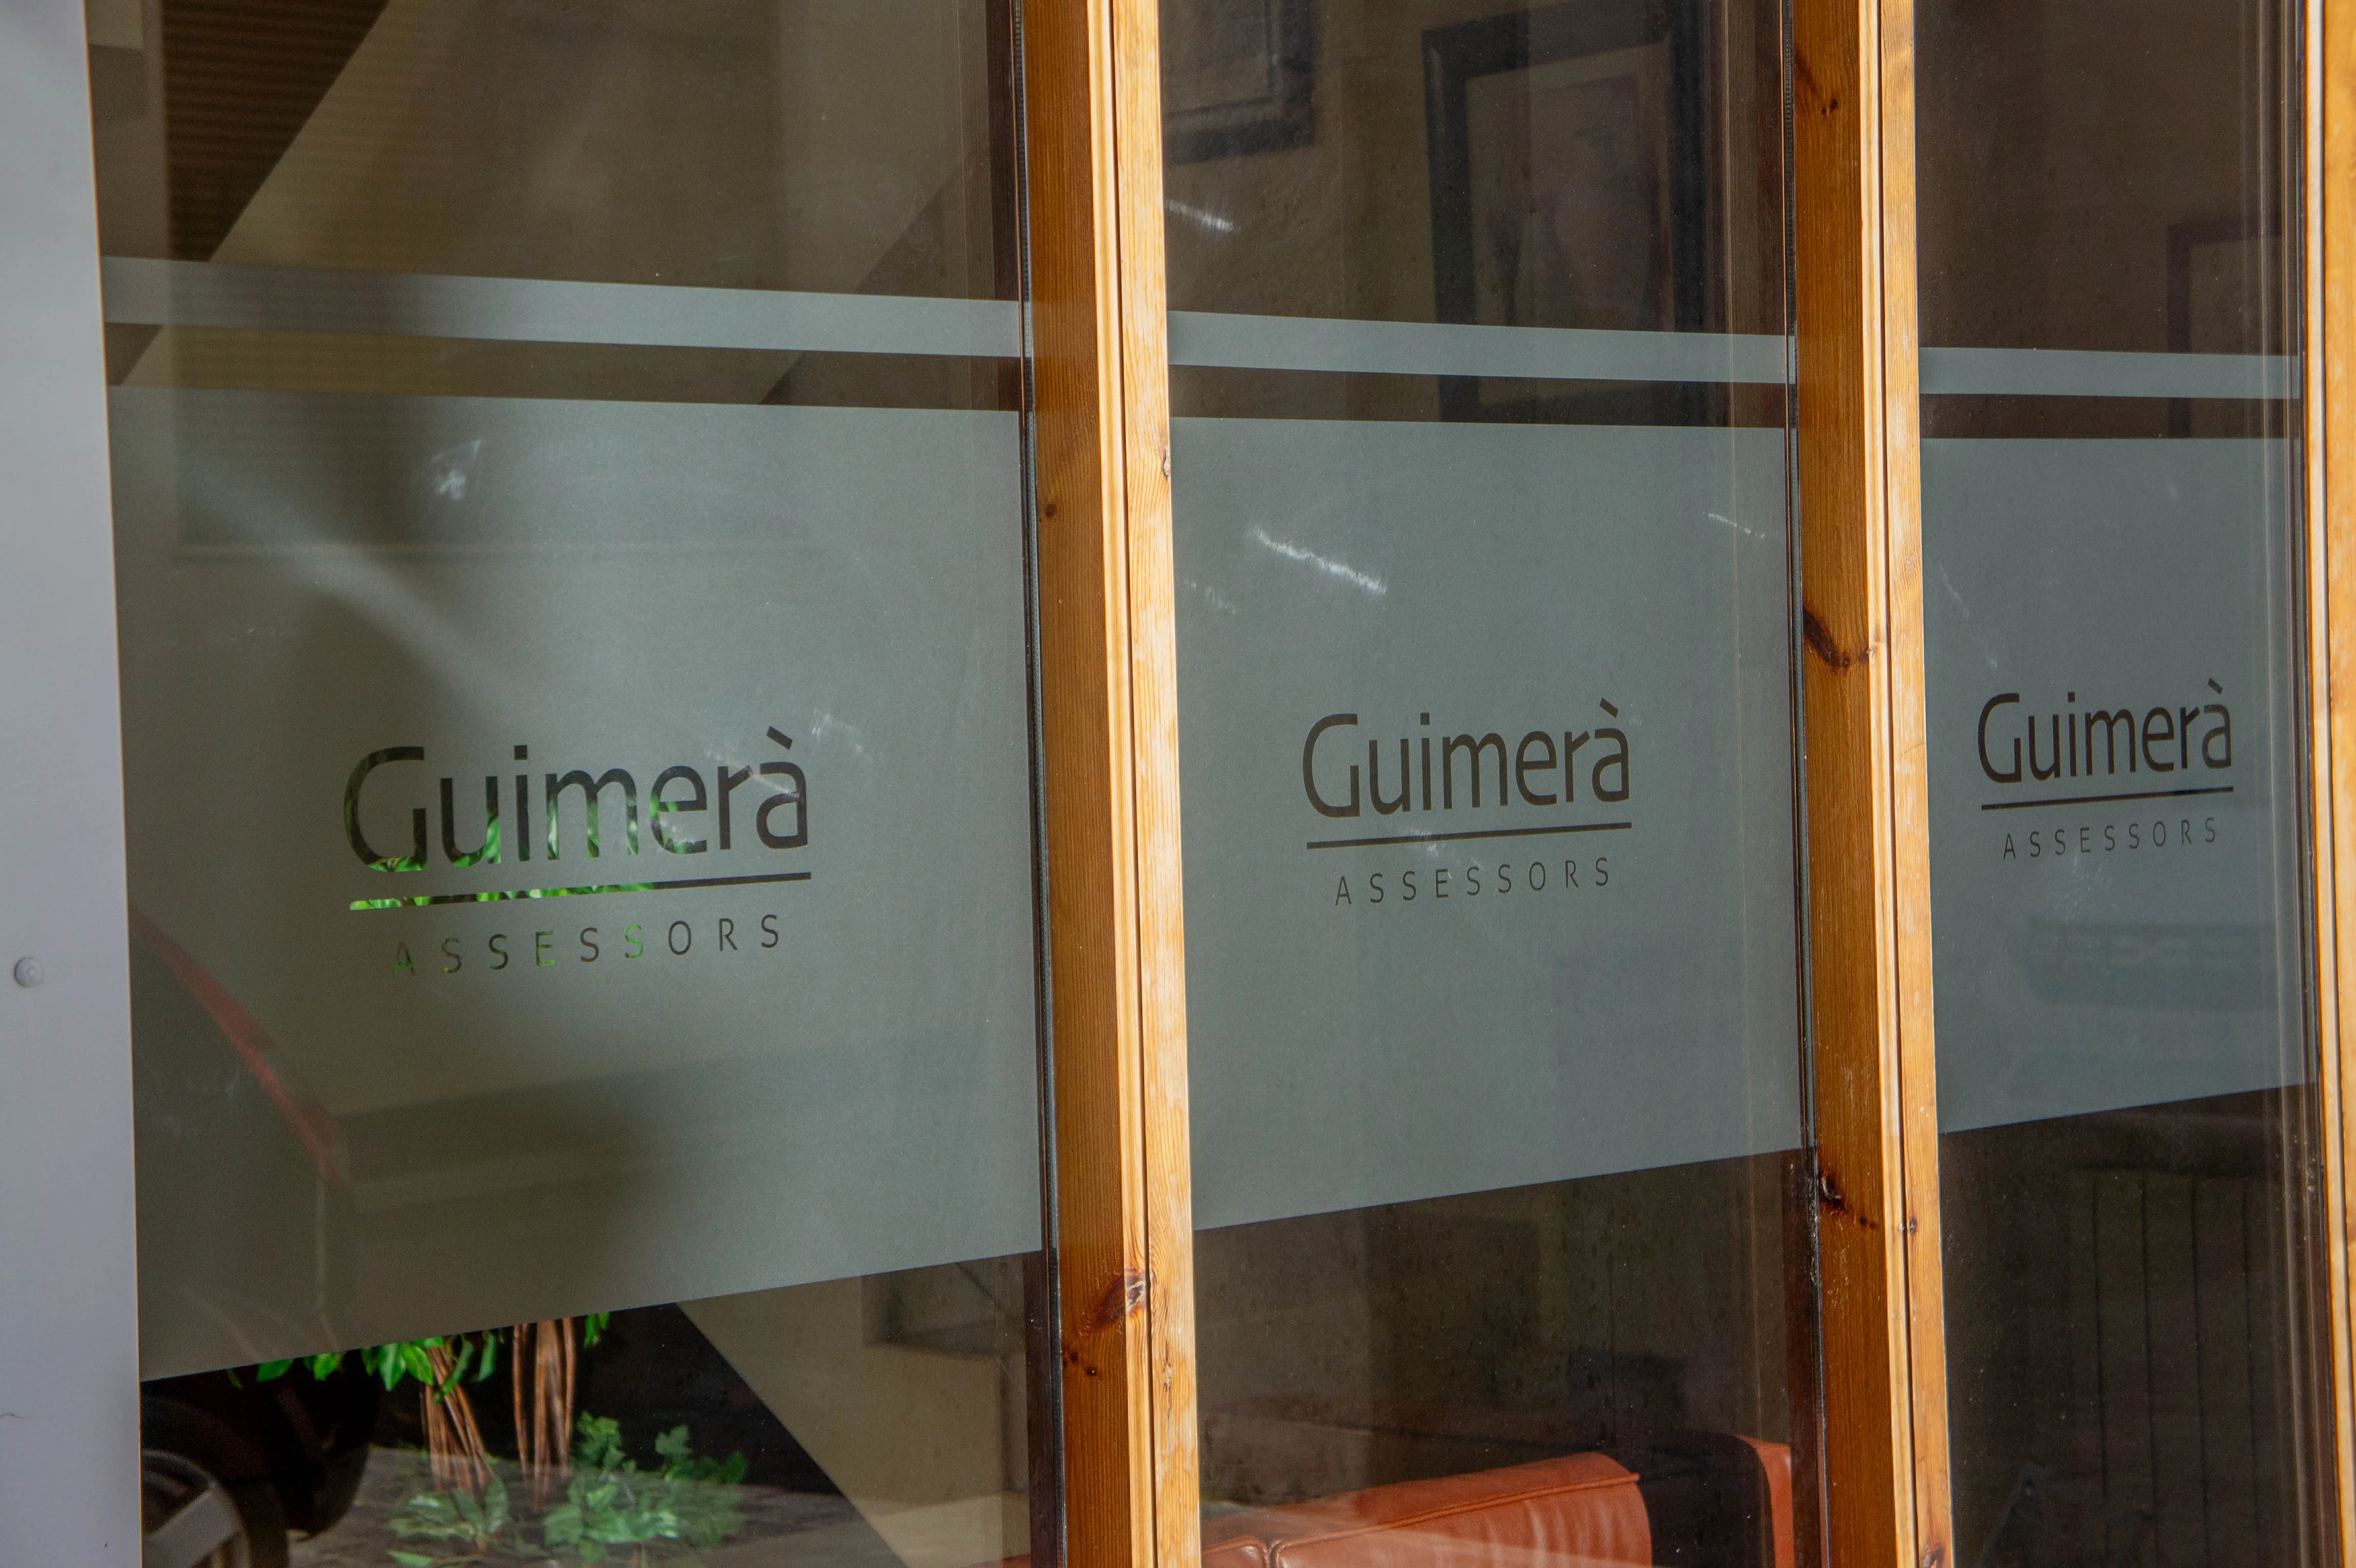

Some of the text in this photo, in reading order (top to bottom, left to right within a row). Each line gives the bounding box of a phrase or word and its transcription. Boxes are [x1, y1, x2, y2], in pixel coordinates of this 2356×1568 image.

[1302, 698, 1629, 818] Guimerà
[1978, 678, 2232, 783] Guimerà
[344, 726, 809, 872] Guimerà
[2003, 817, 2216, 859] ASSESSORS
[1335, 858, 1608, 906] ASSESSORS
[391, 914, 779, 977] ASSESSORS
